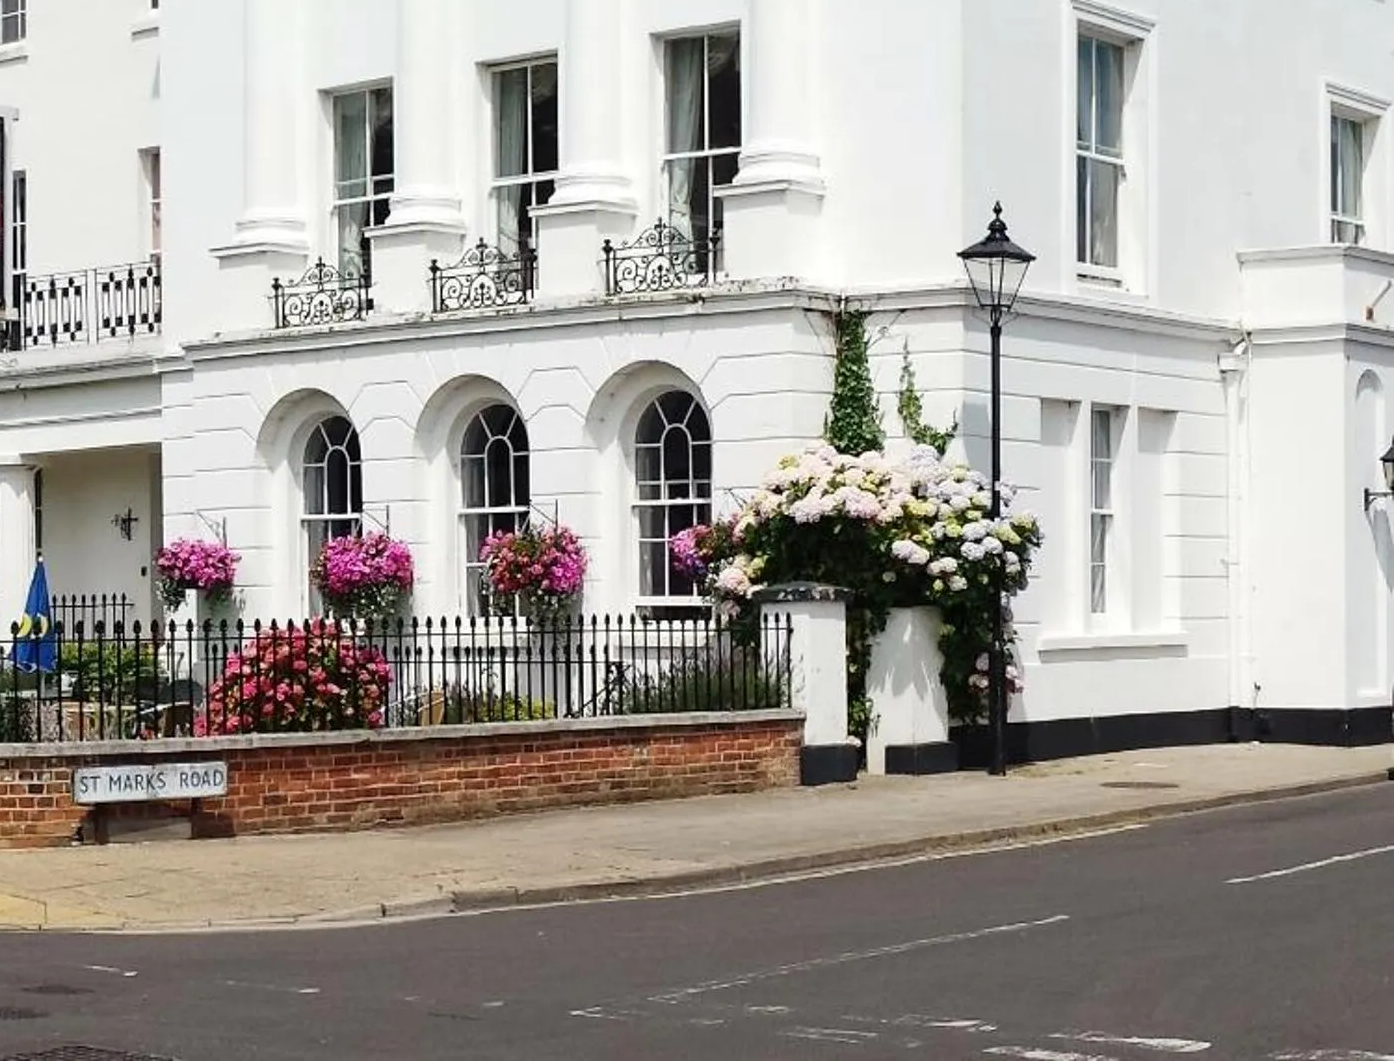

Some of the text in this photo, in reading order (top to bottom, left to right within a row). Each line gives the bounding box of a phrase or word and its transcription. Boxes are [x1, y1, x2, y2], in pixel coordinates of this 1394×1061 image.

[80, 769, 224, 794] ST MARKS ROAD
